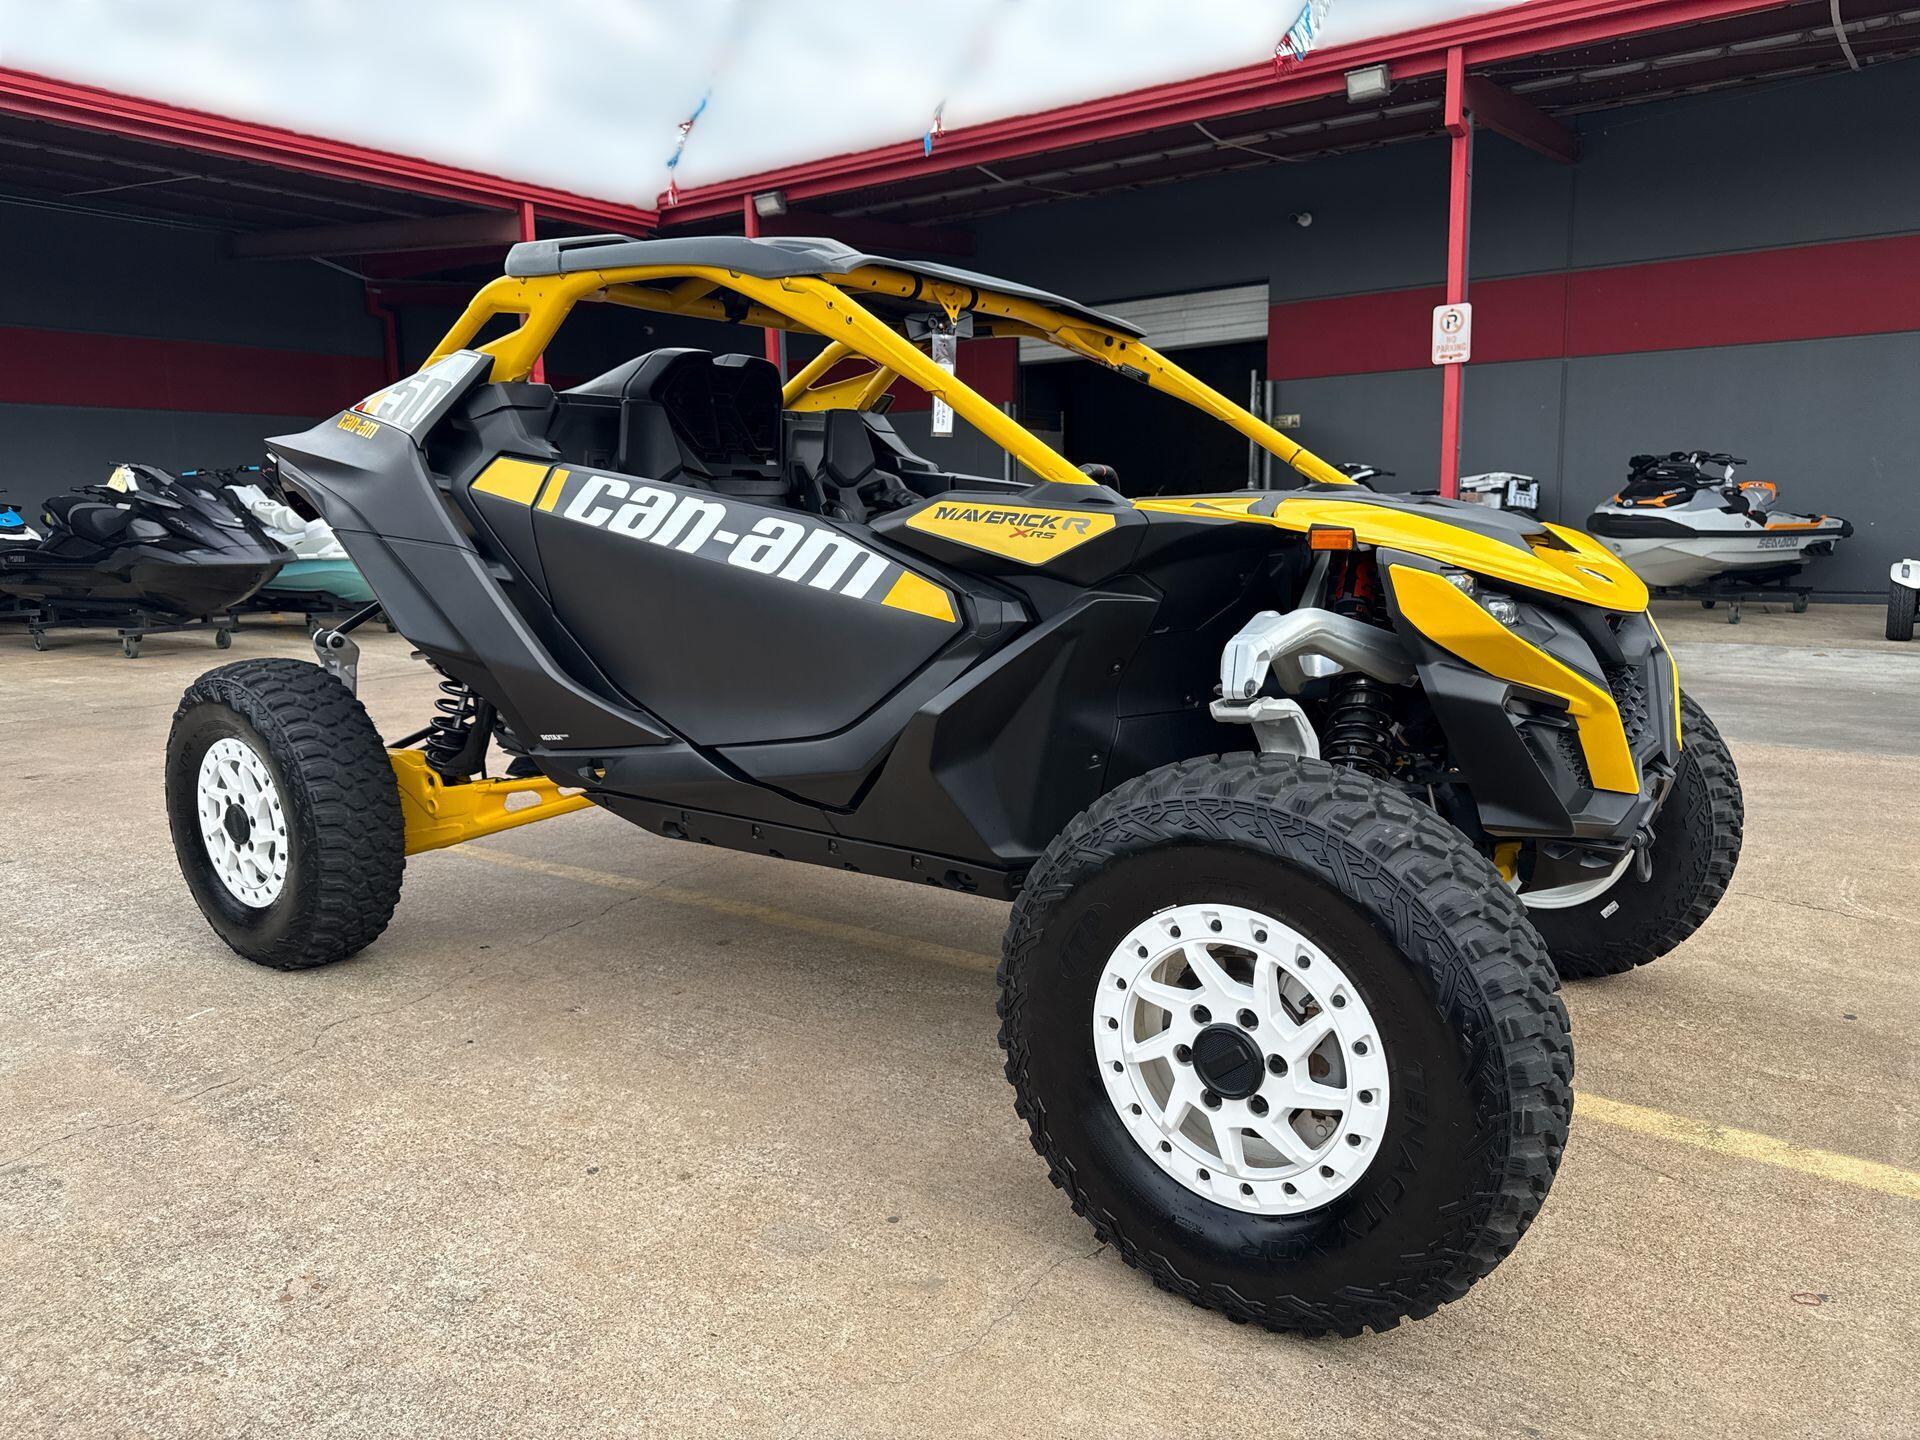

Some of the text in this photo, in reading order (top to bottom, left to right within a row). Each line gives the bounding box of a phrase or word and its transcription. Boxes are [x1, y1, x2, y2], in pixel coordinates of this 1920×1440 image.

[336, 412, 380, 440] can-am
[934, 507, 1092, 535] MAVERICK R
[1008, 527, 1057, 539] XRS
[563, 475, 891, 600] can-am
